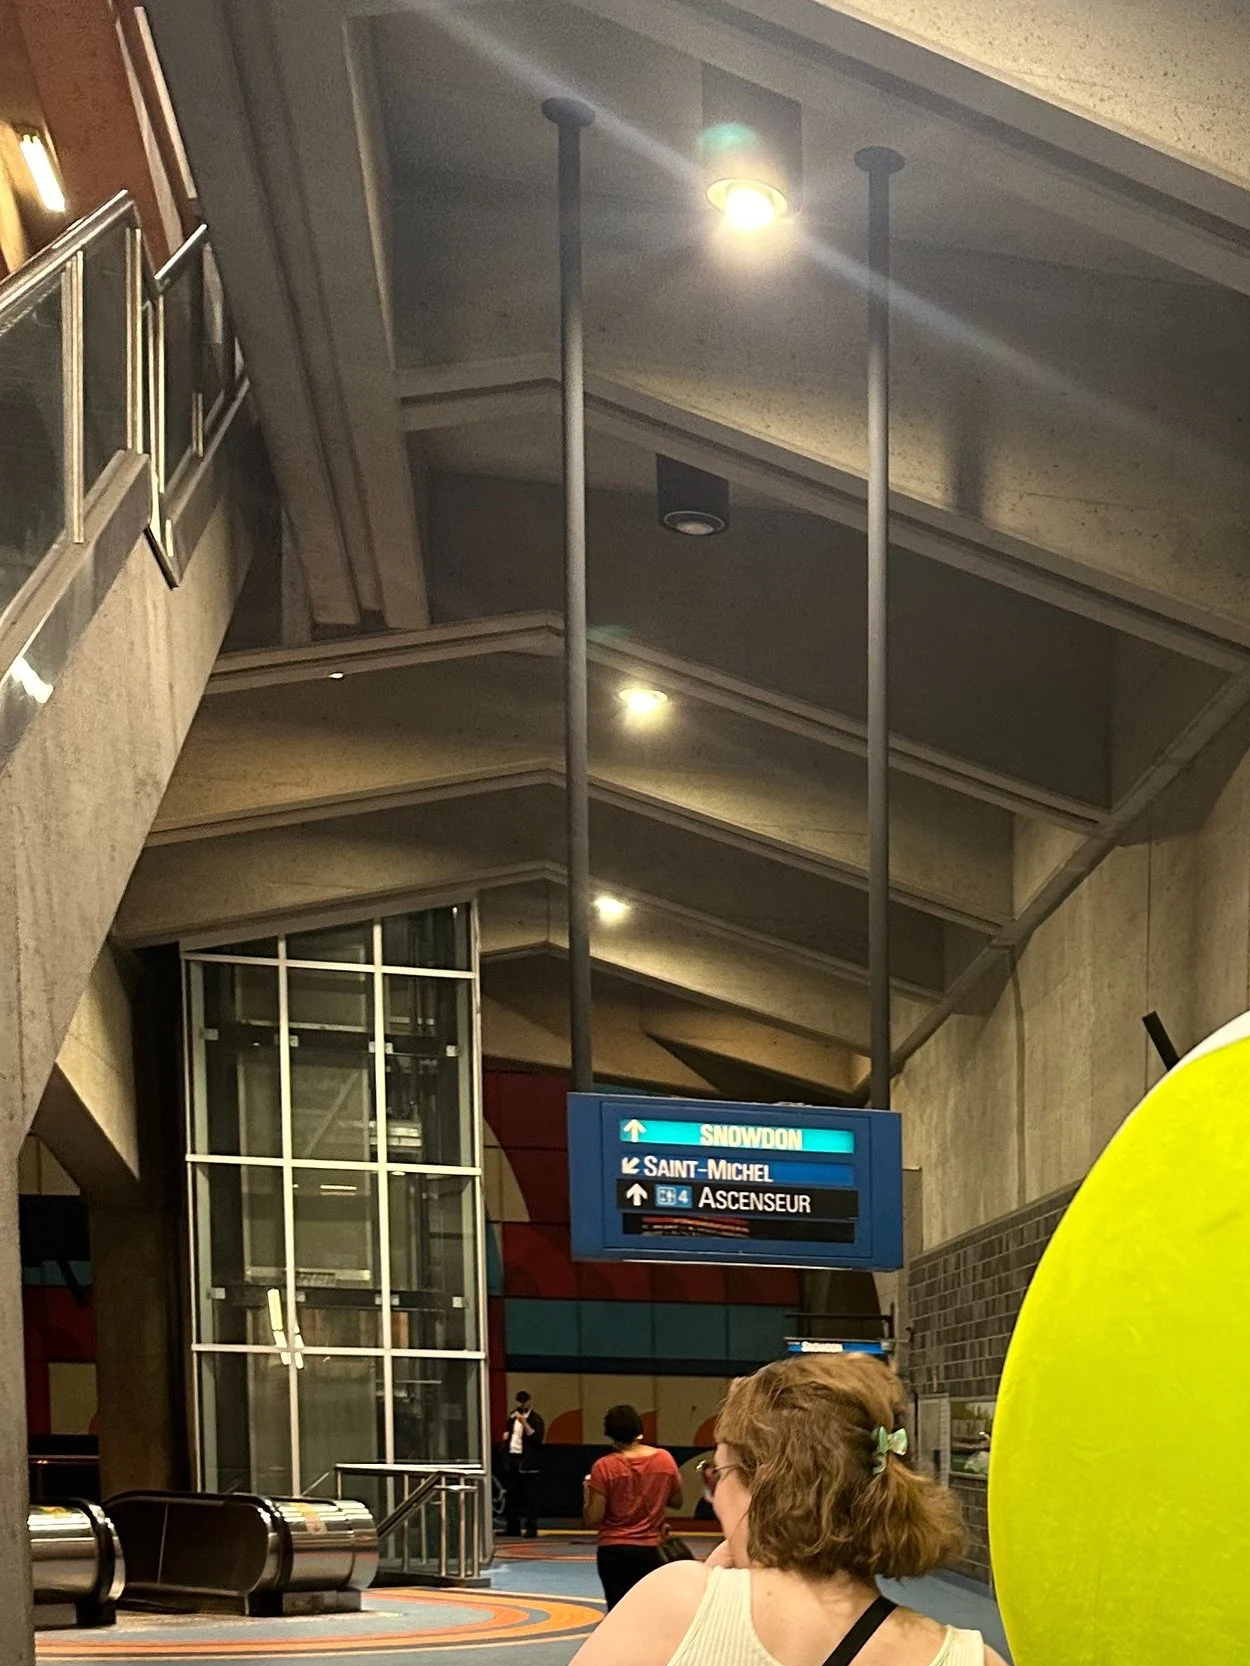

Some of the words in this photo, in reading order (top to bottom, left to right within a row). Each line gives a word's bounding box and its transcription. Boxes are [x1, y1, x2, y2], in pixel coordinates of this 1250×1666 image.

[700, 1123, 803, 1150] SNOWDON
[643, 1155, 774, 1183] SAINT-MICHEL
[698, 1186, 811, 1213] ASCENSEUR
